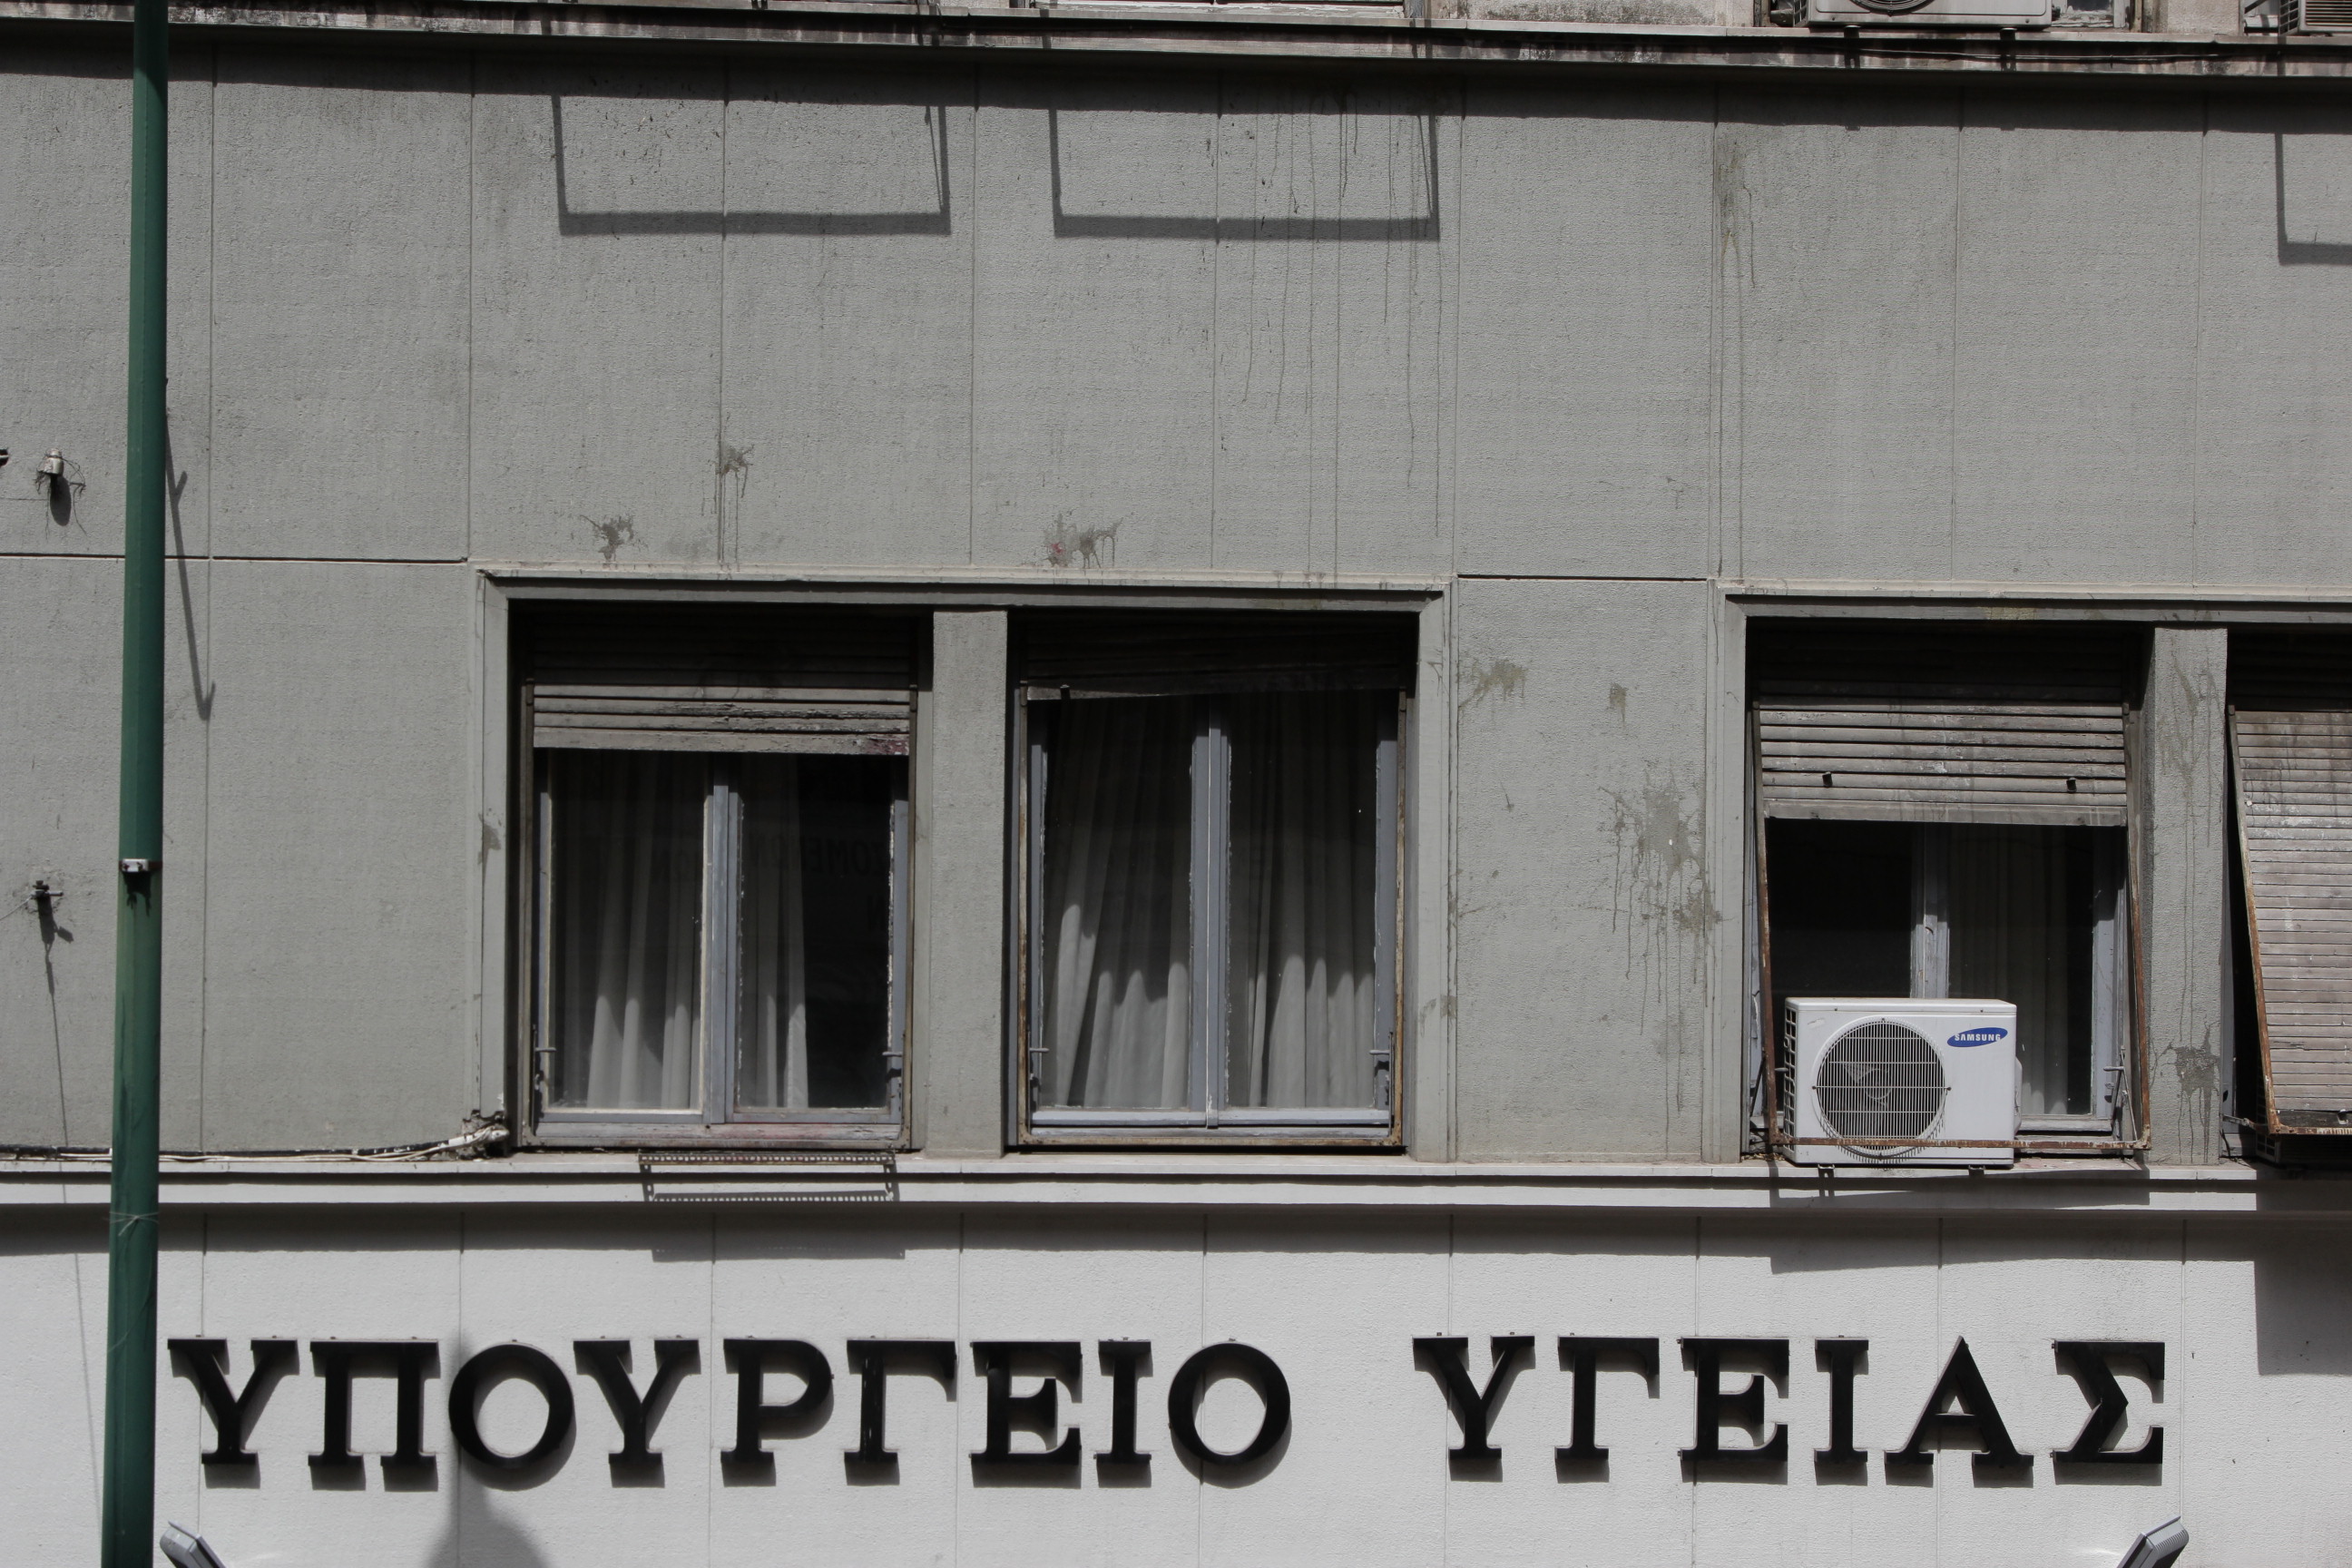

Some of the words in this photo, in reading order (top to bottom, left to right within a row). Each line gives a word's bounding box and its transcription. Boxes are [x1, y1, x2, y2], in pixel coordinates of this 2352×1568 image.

[1954, 1034, 2002, 1042] SAMSUNG
[167, 1338, 1291, 1468] ΥΠΟΥΡΓΕΙΟ
[1412, 1336, 2165, 1466] ΥΓΕΙΑΣ
